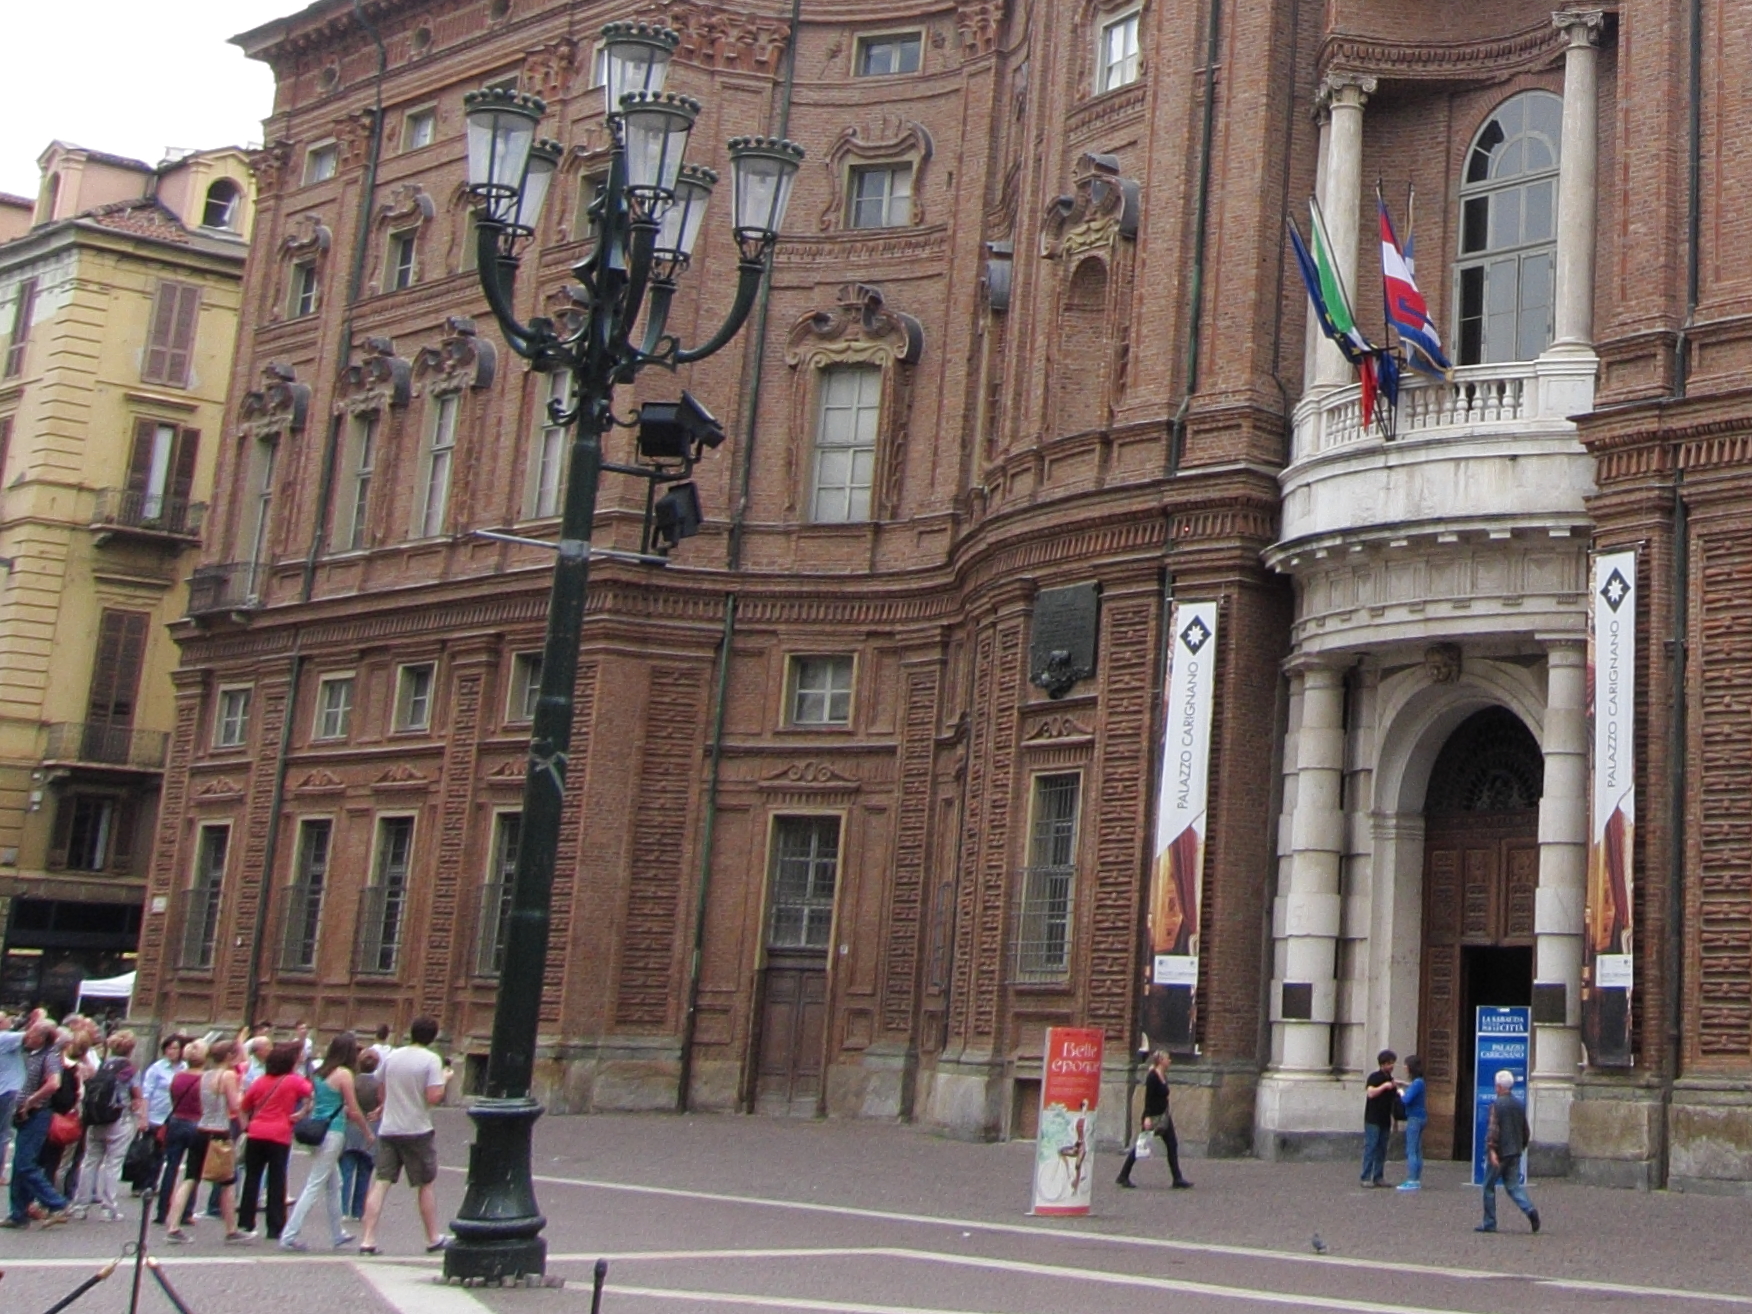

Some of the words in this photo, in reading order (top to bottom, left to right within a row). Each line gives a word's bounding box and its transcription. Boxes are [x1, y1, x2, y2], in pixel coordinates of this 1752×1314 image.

[1608, 620, 1620, 717] CARIGNANO
[1182, 661, 1199, 747] CARIGNANO
[1177, 750, 1193, 810] PALAZZO
[1607, 720, 1618, 788] PALAZZO
[1063, 1042, 1097, 1057] Belle
